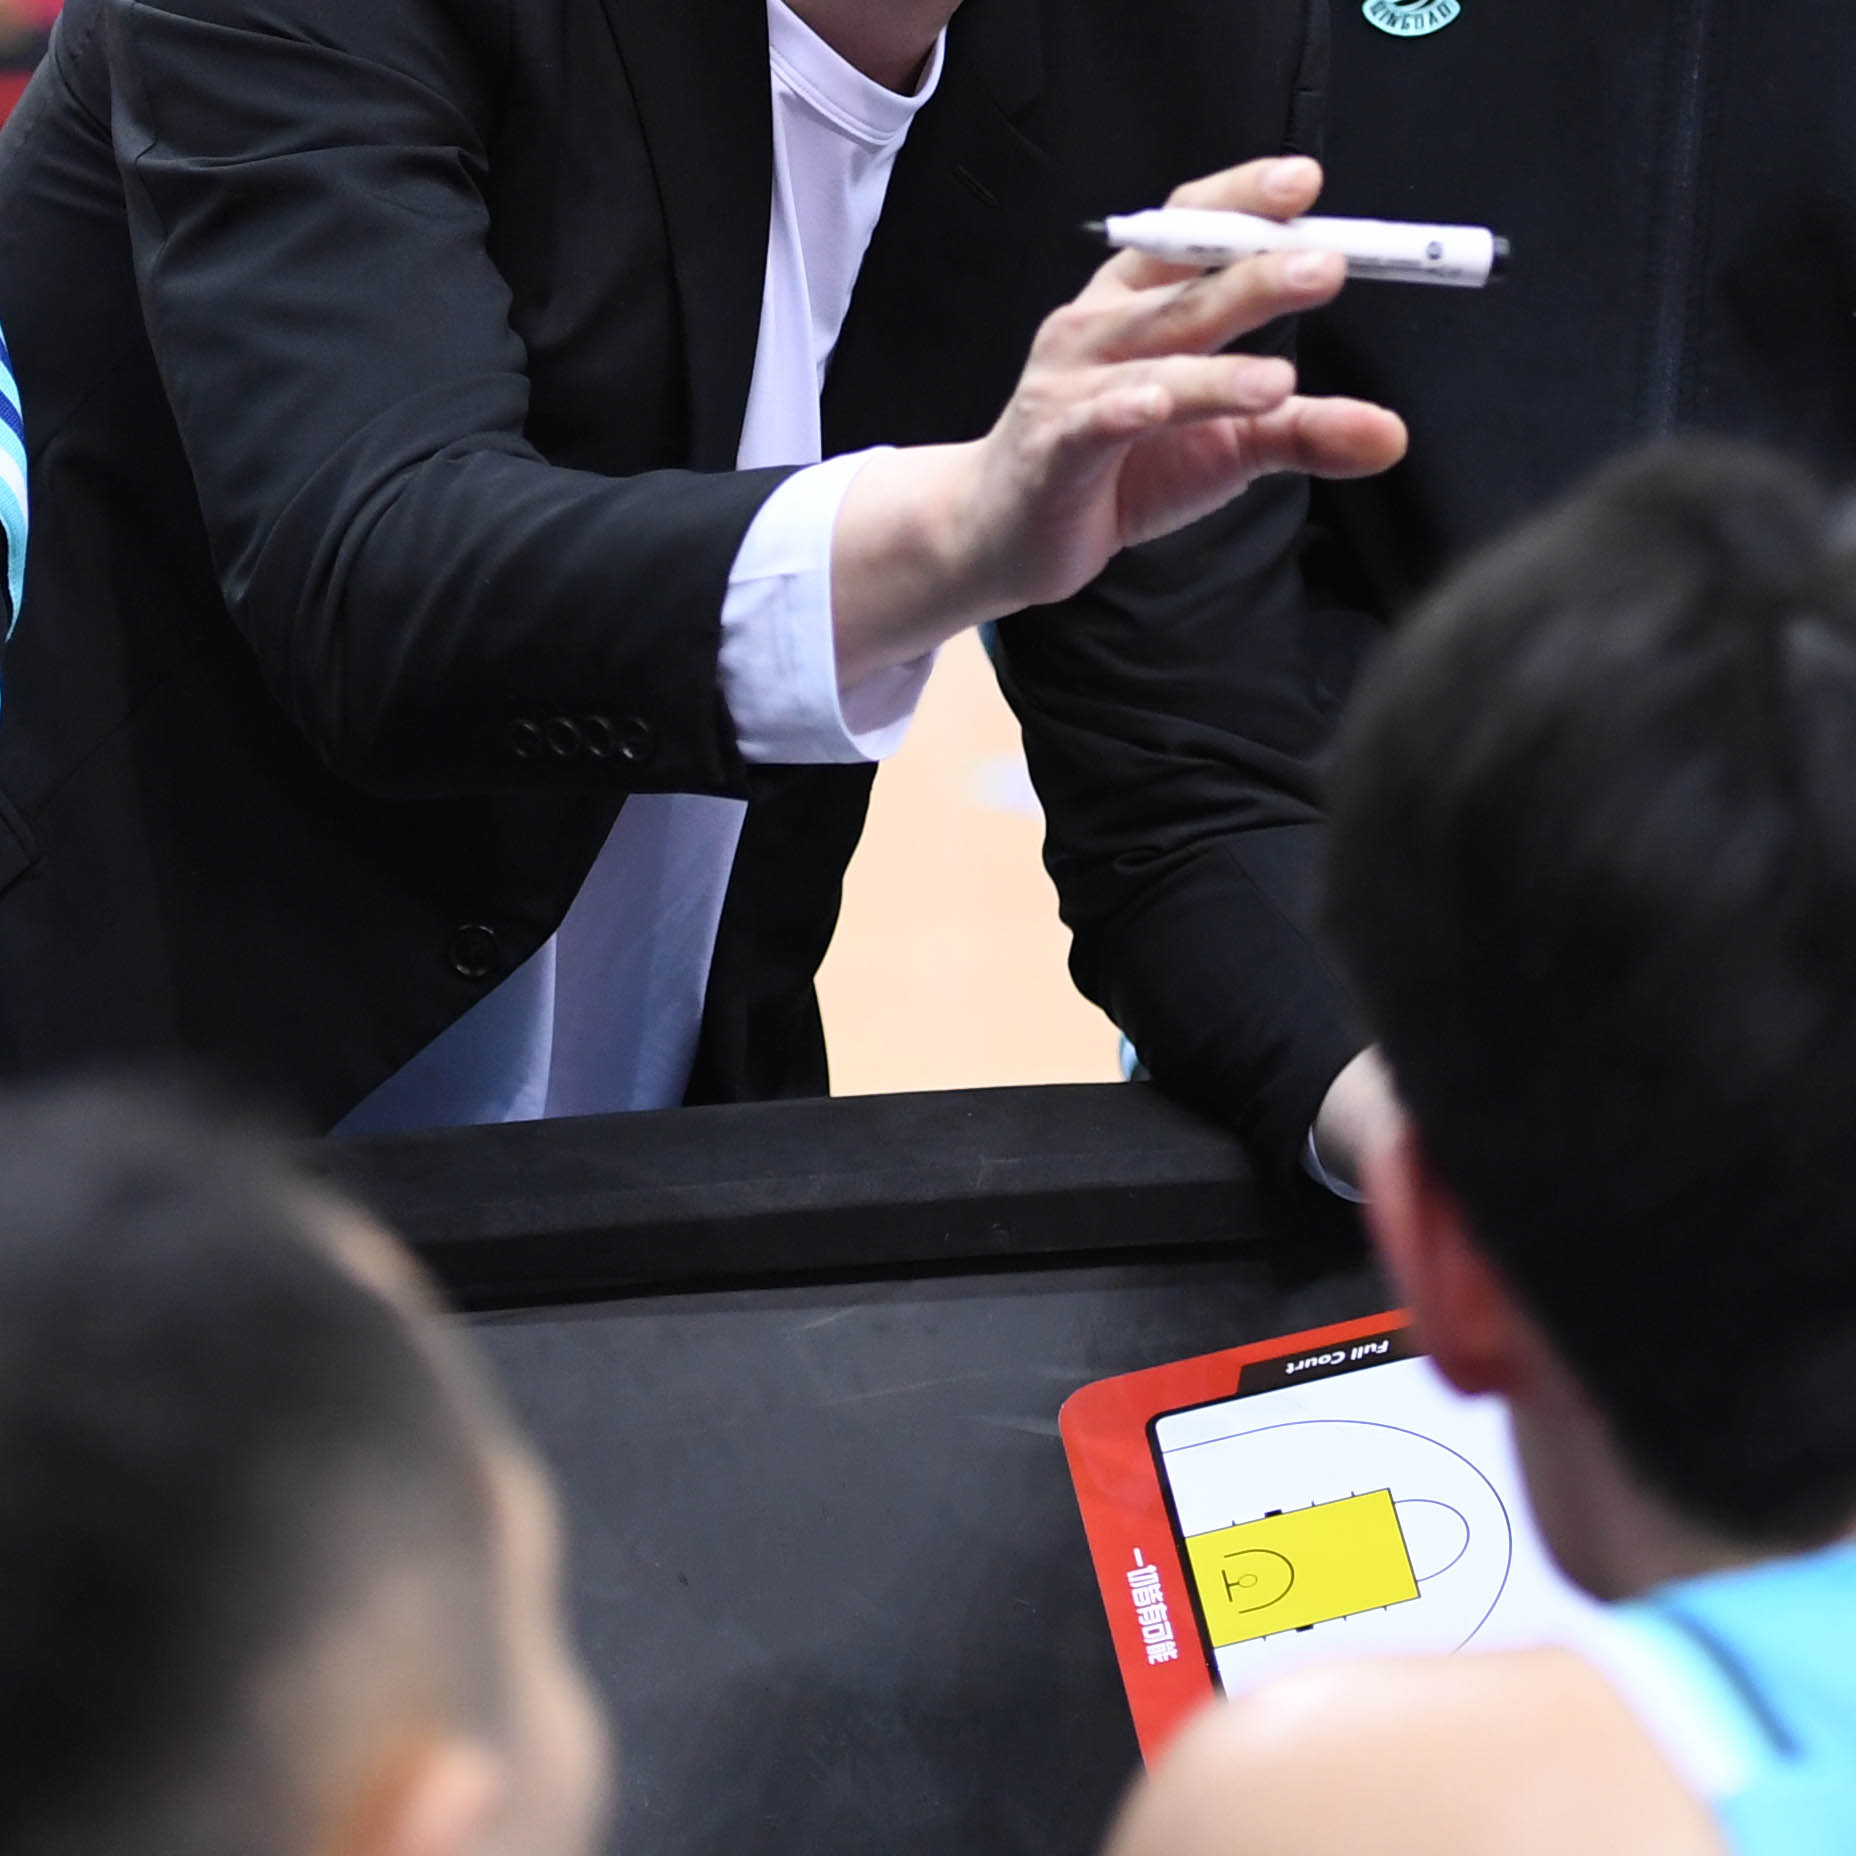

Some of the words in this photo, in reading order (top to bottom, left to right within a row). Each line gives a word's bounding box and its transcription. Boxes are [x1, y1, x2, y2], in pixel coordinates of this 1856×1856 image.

[1351, 1340, 1389, 1360] Full
[1286, 1351, 1346, 1374] Court
[1127, 1547, 1178, 1664] 一切皆有可能
